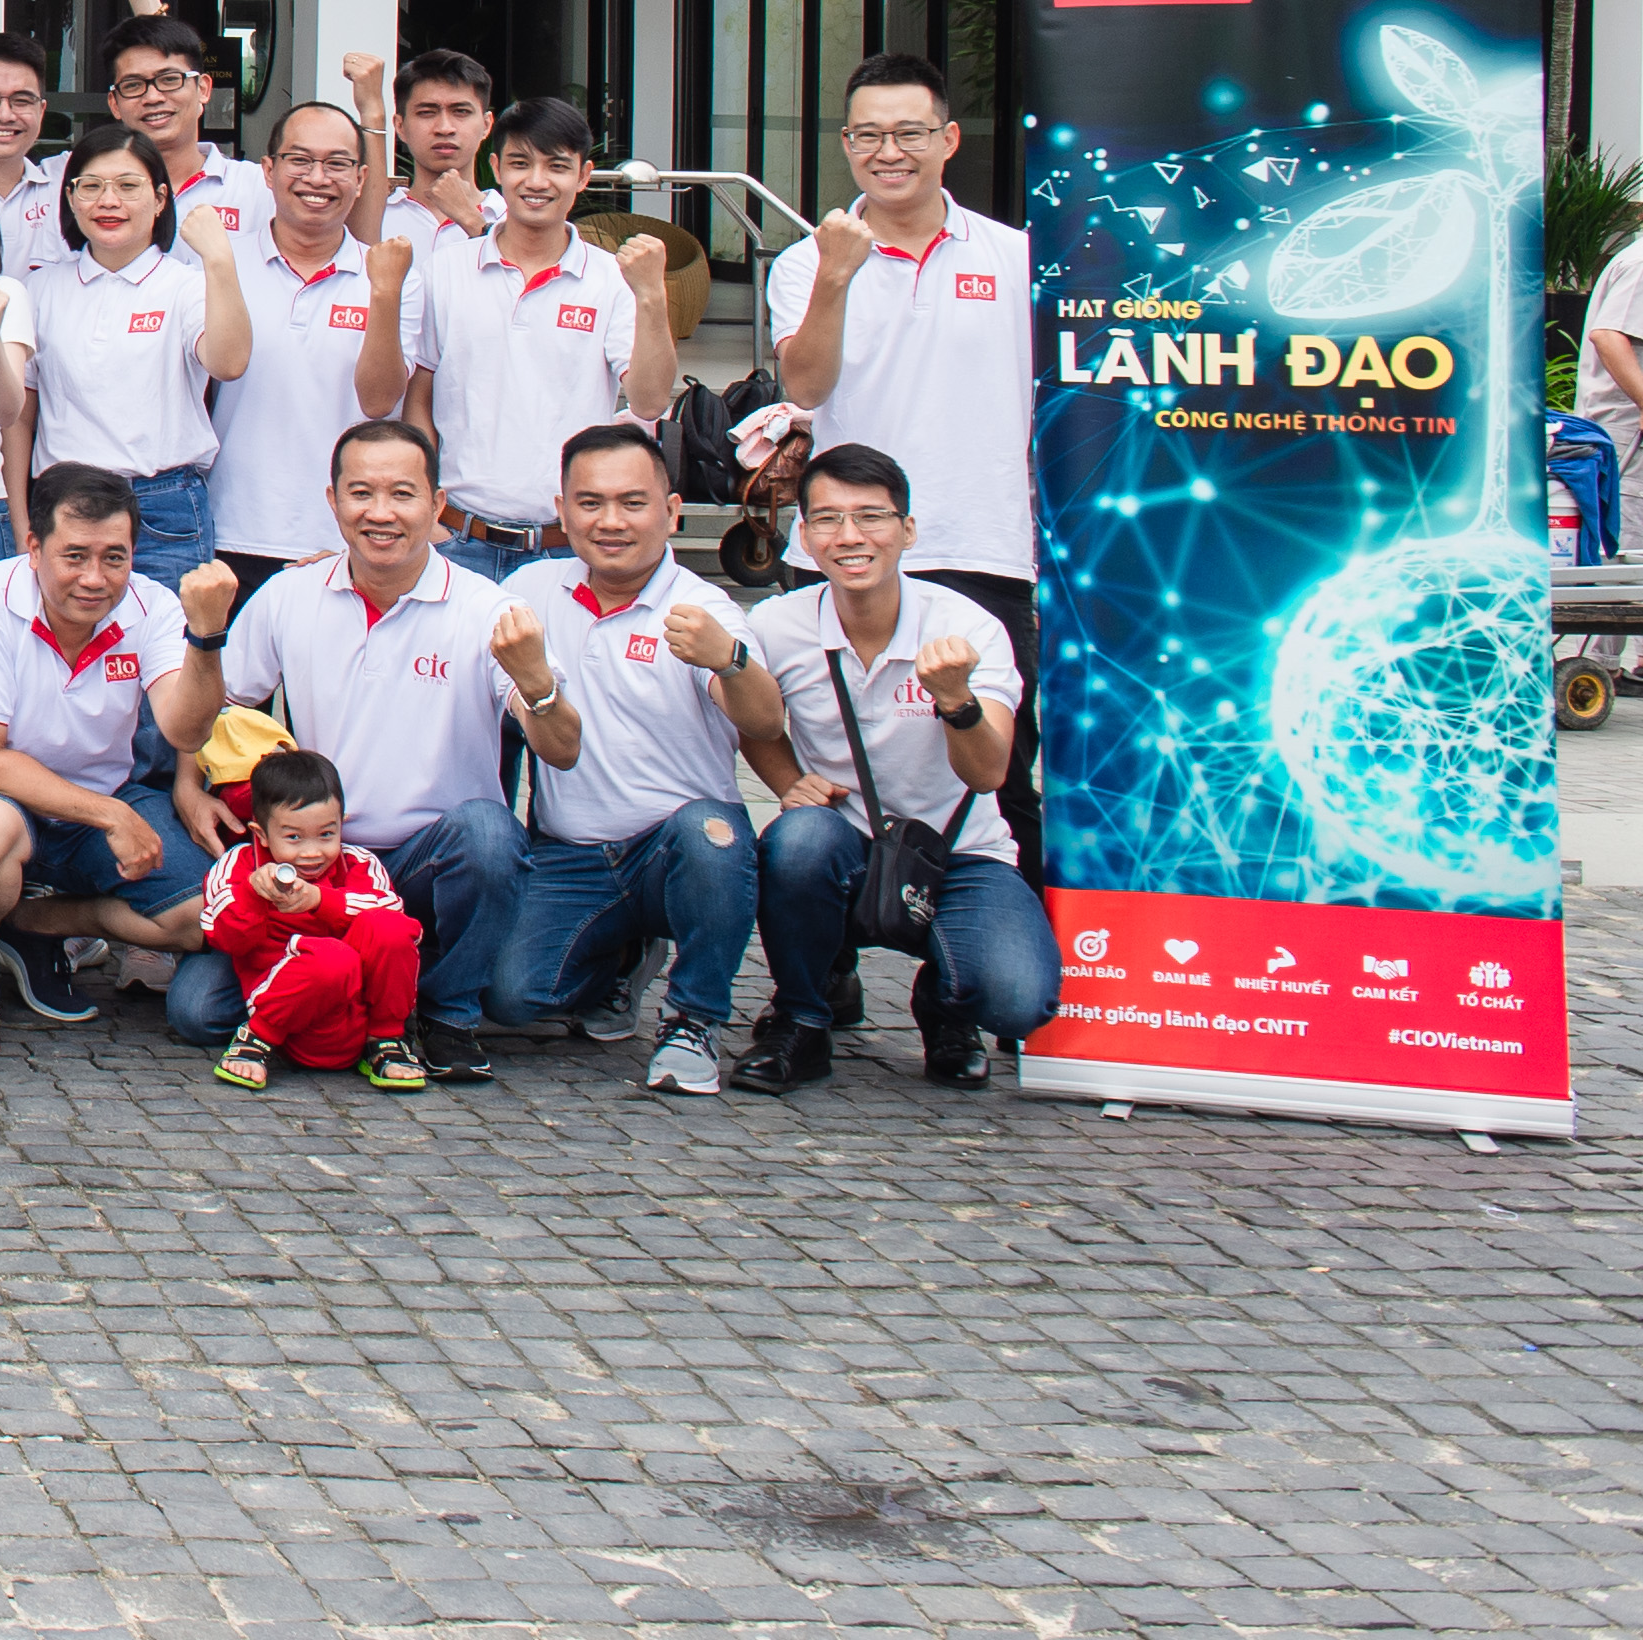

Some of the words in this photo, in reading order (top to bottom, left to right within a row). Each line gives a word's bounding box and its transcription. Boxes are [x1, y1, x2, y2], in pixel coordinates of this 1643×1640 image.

[1058, 327, 1256, 387] LÃNH
[1284, 334, 1455, 409] ĐẠO
[1154, 407, 1229, 429] CÔNG
[1234, 409, 1307, 436] NGHỆ
[1312, 410, 1407, 434] THÔNG
[1410, 416, 1457, 435] TIN
[1095, 962, 1127, 980] BÃO
[1152, 970, 1183, 986] ĐAM
[1185, 970, 1212, 987] MÊ
[1234, 975, 1277, 995] NHIỆT
[1279, 976, 1331, 997] HUYẾT
[1351, 984, 1383, 1001] CAM
[1384, 985, 1419, 1002] KẾT
[1456, 989, 1482, 1008] TỐ
[1483, 990, 1525, 1012] CHẤT
[1057, 1003, 1102, 1025] #Hạt
[1104, 1004, 1161, 1030] giống
[1164, 1007, 1209, 1030] lãnh
[1212, 1012, 1251, 1036] đạo
[1253, 1016, 1310, 1038] CNTT
[1387, 1028, 1525, 1055] #CIOVietnam
